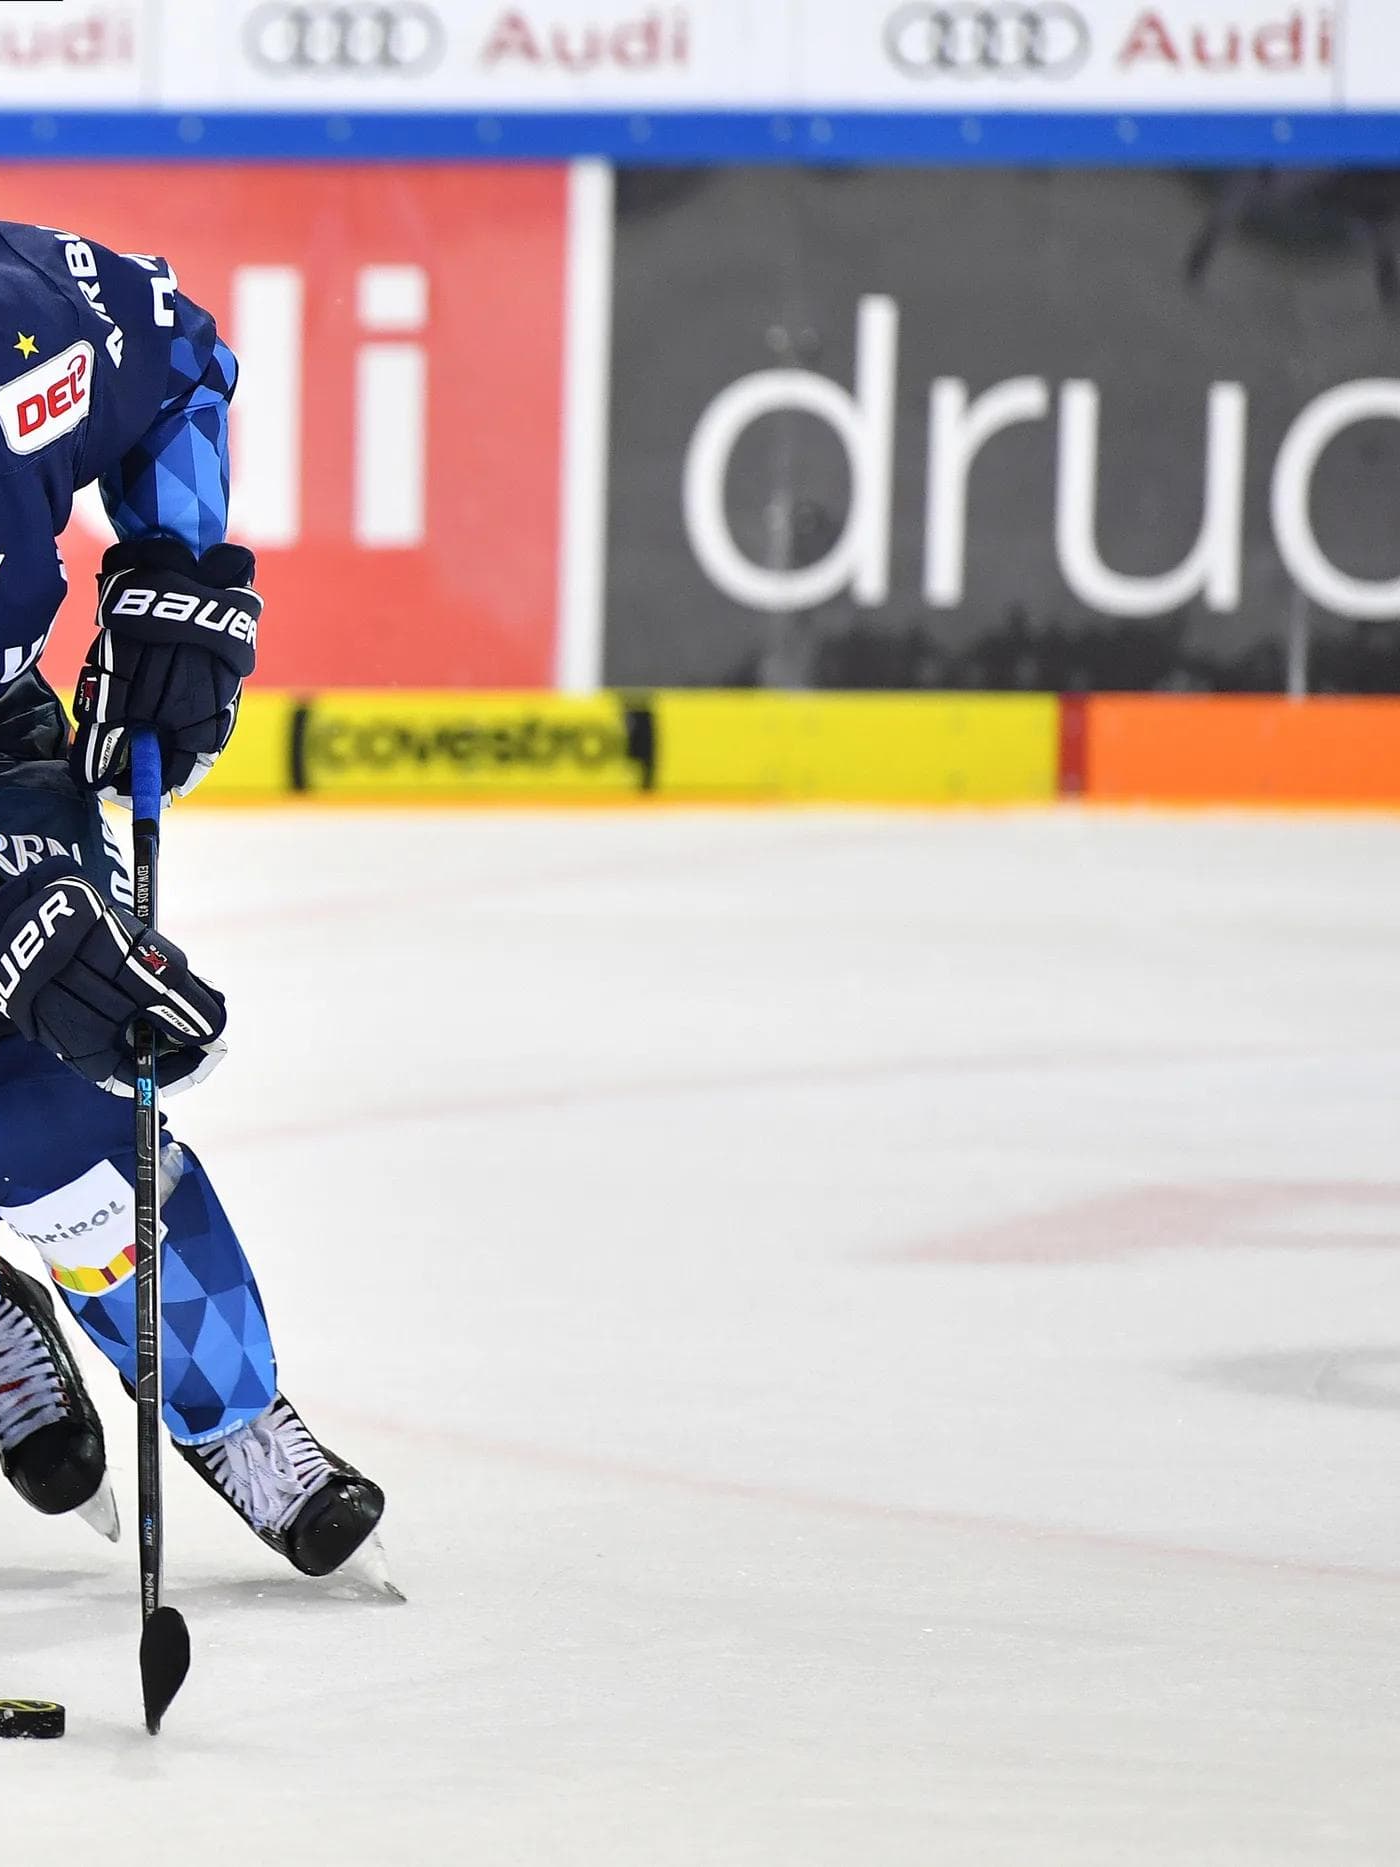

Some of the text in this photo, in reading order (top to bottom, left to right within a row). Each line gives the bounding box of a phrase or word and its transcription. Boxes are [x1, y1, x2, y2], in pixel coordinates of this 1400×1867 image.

[481, 9, 690, 72] Audi
[1118, 10, 1333, 70] Audi
[16, 354, 87, 438] DEL
[136, 865, 150, 903] EDWARDS
